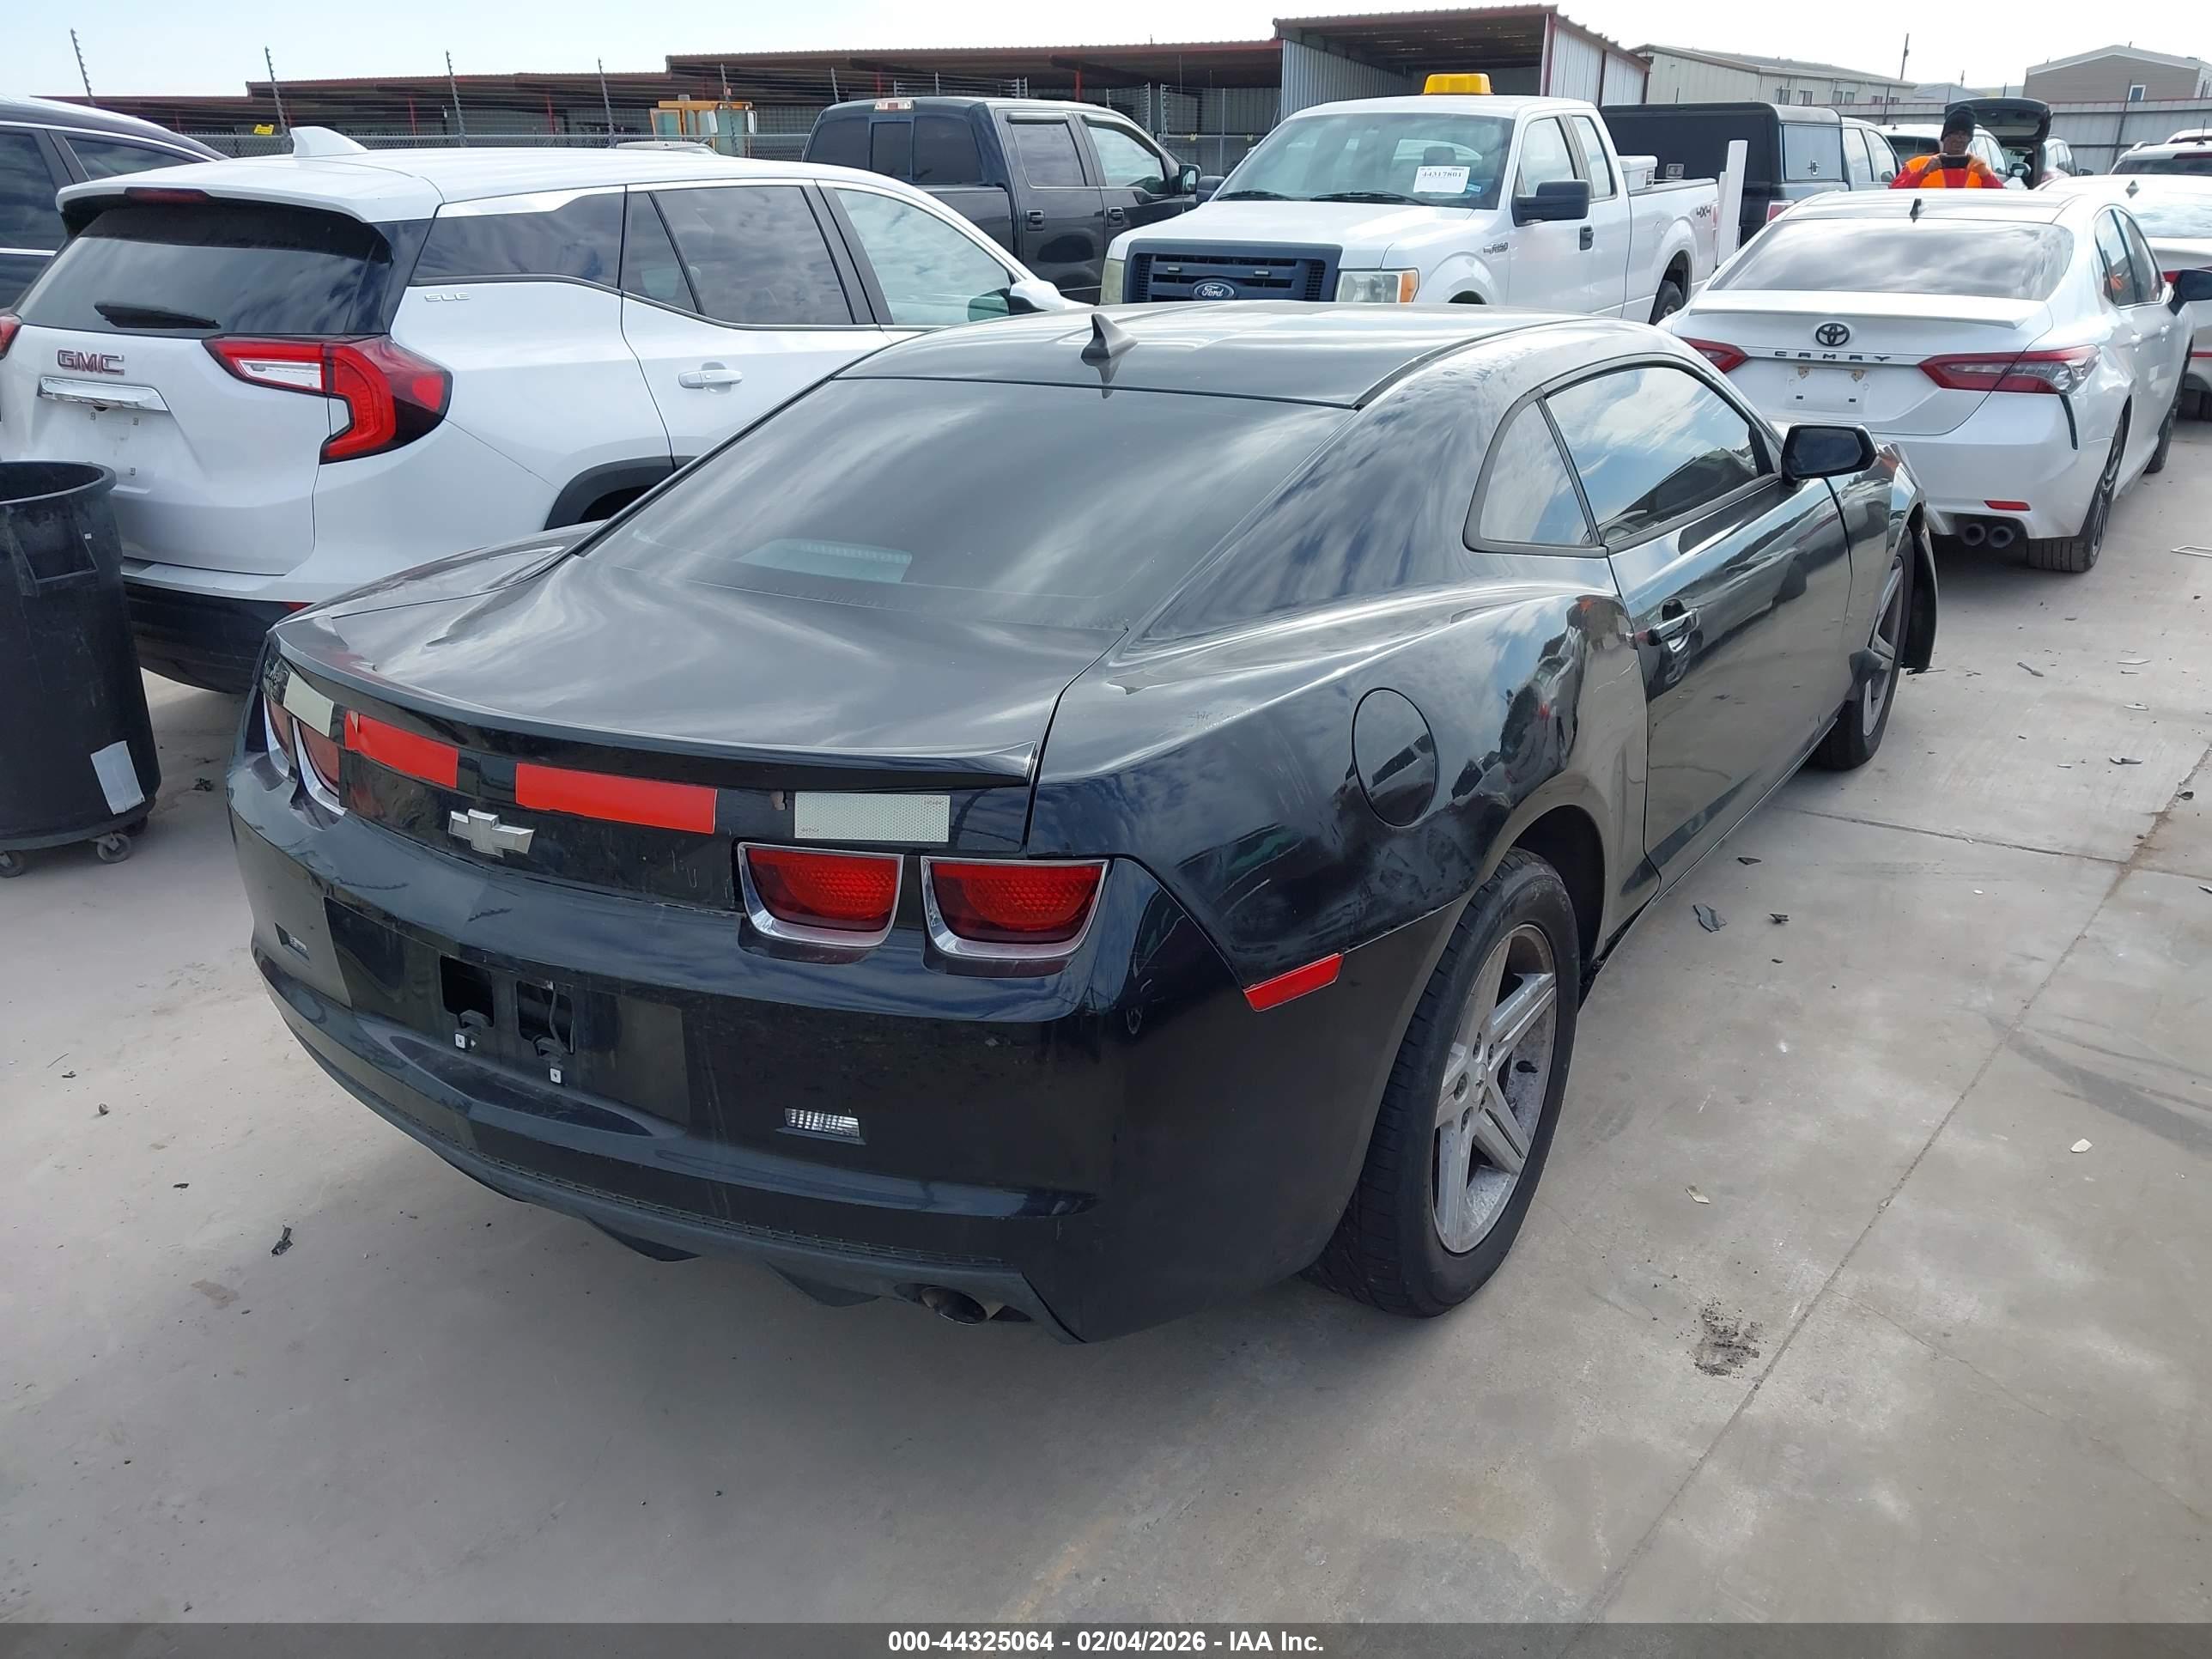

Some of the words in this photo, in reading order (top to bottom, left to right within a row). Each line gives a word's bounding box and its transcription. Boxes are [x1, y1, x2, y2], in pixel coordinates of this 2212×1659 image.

[424, 292, 471, 302] SLE
[1201, 285, 1224, 297] Ford
[1774, 349, 1892, 362] CAMRY
[57, 349, 125, 376] GMC
